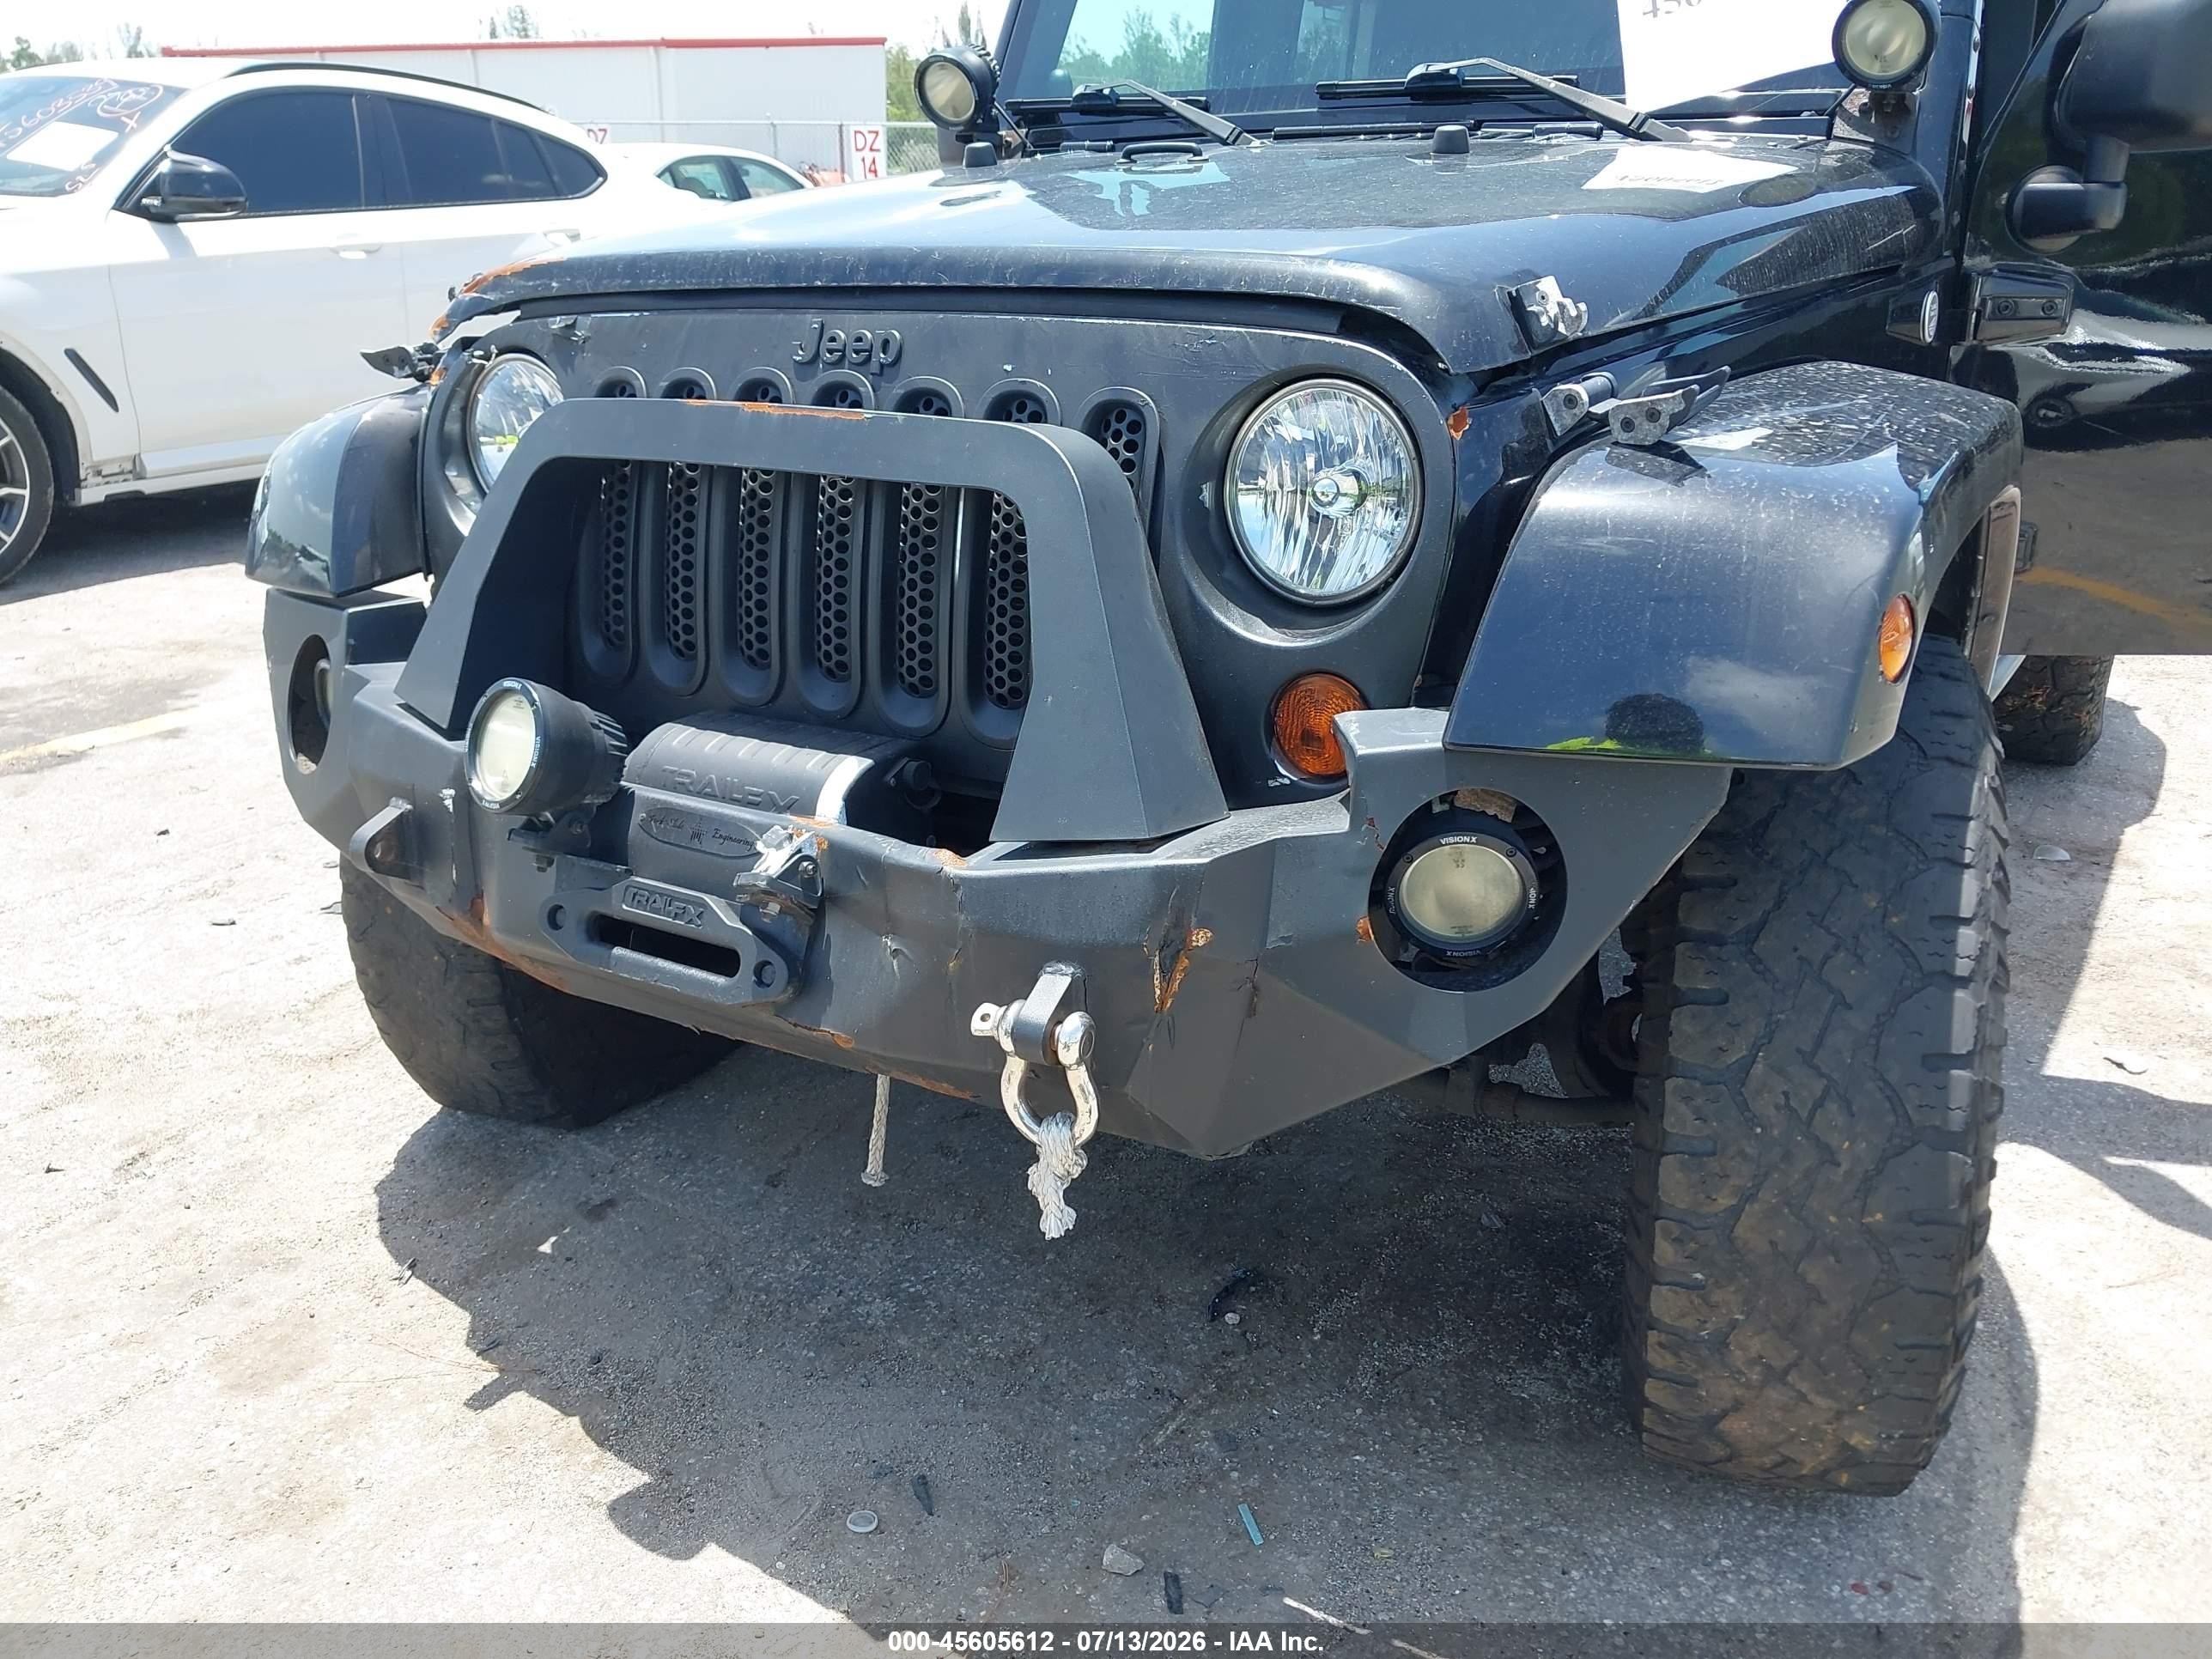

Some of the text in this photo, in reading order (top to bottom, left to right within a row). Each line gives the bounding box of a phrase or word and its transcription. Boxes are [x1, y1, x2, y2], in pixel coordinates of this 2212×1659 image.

[854, 130, 881, 152] DZ
[861, 156, 878, 179] 14
[792, 318, 903, 376] Jeep
[711, 828, 756, 852] Engineering
[1440, 836, 1478, 846] VISIONX
